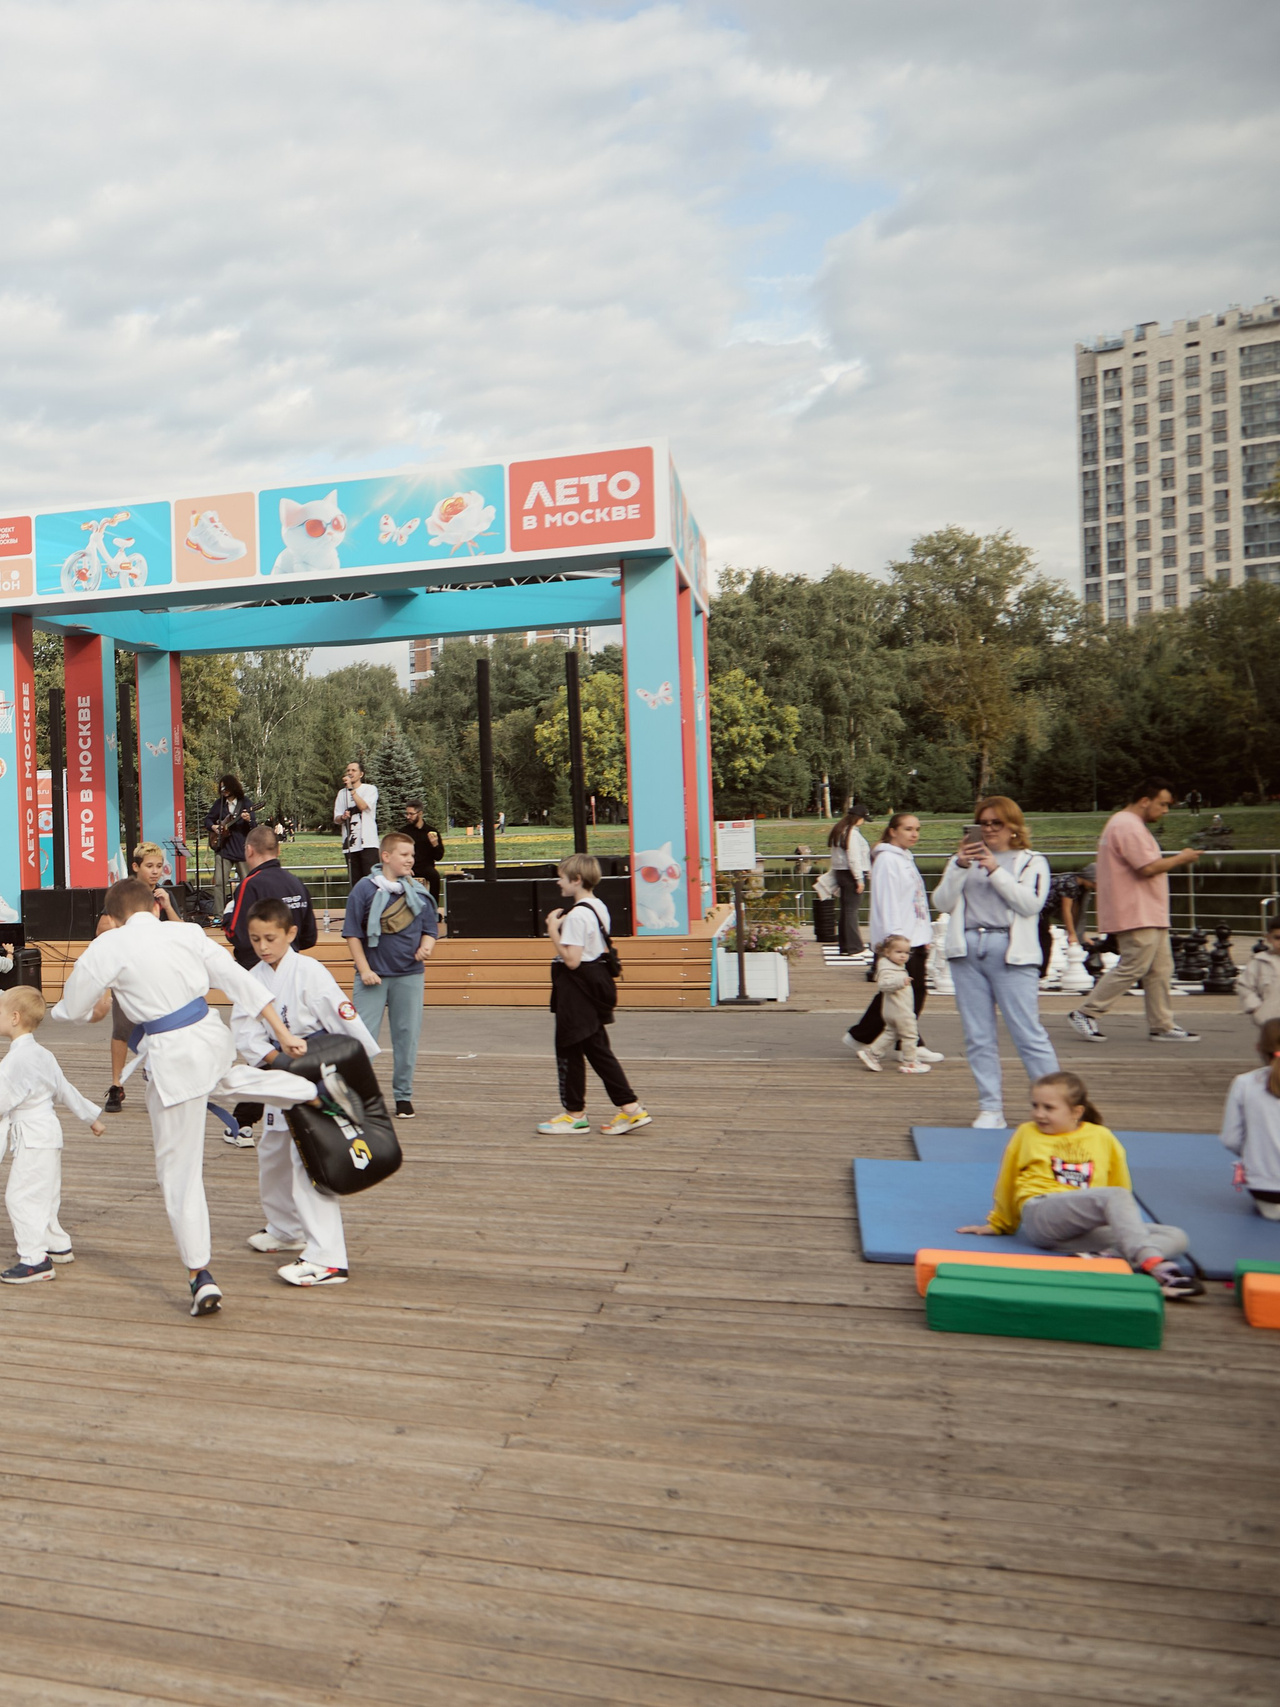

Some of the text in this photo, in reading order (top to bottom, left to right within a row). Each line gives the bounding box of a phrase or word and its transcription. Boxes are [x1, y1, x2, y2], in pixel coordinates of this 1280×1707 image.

[522, 504, 641, 530] В МОСКВЕ
[523, 470, 641, 510] ЛЕТО
[22, 682, 36, 867] ЛЕТО В МОСКВЕ
[77, 695, 95, 862] ЛЕТО В МОСКВЕ
